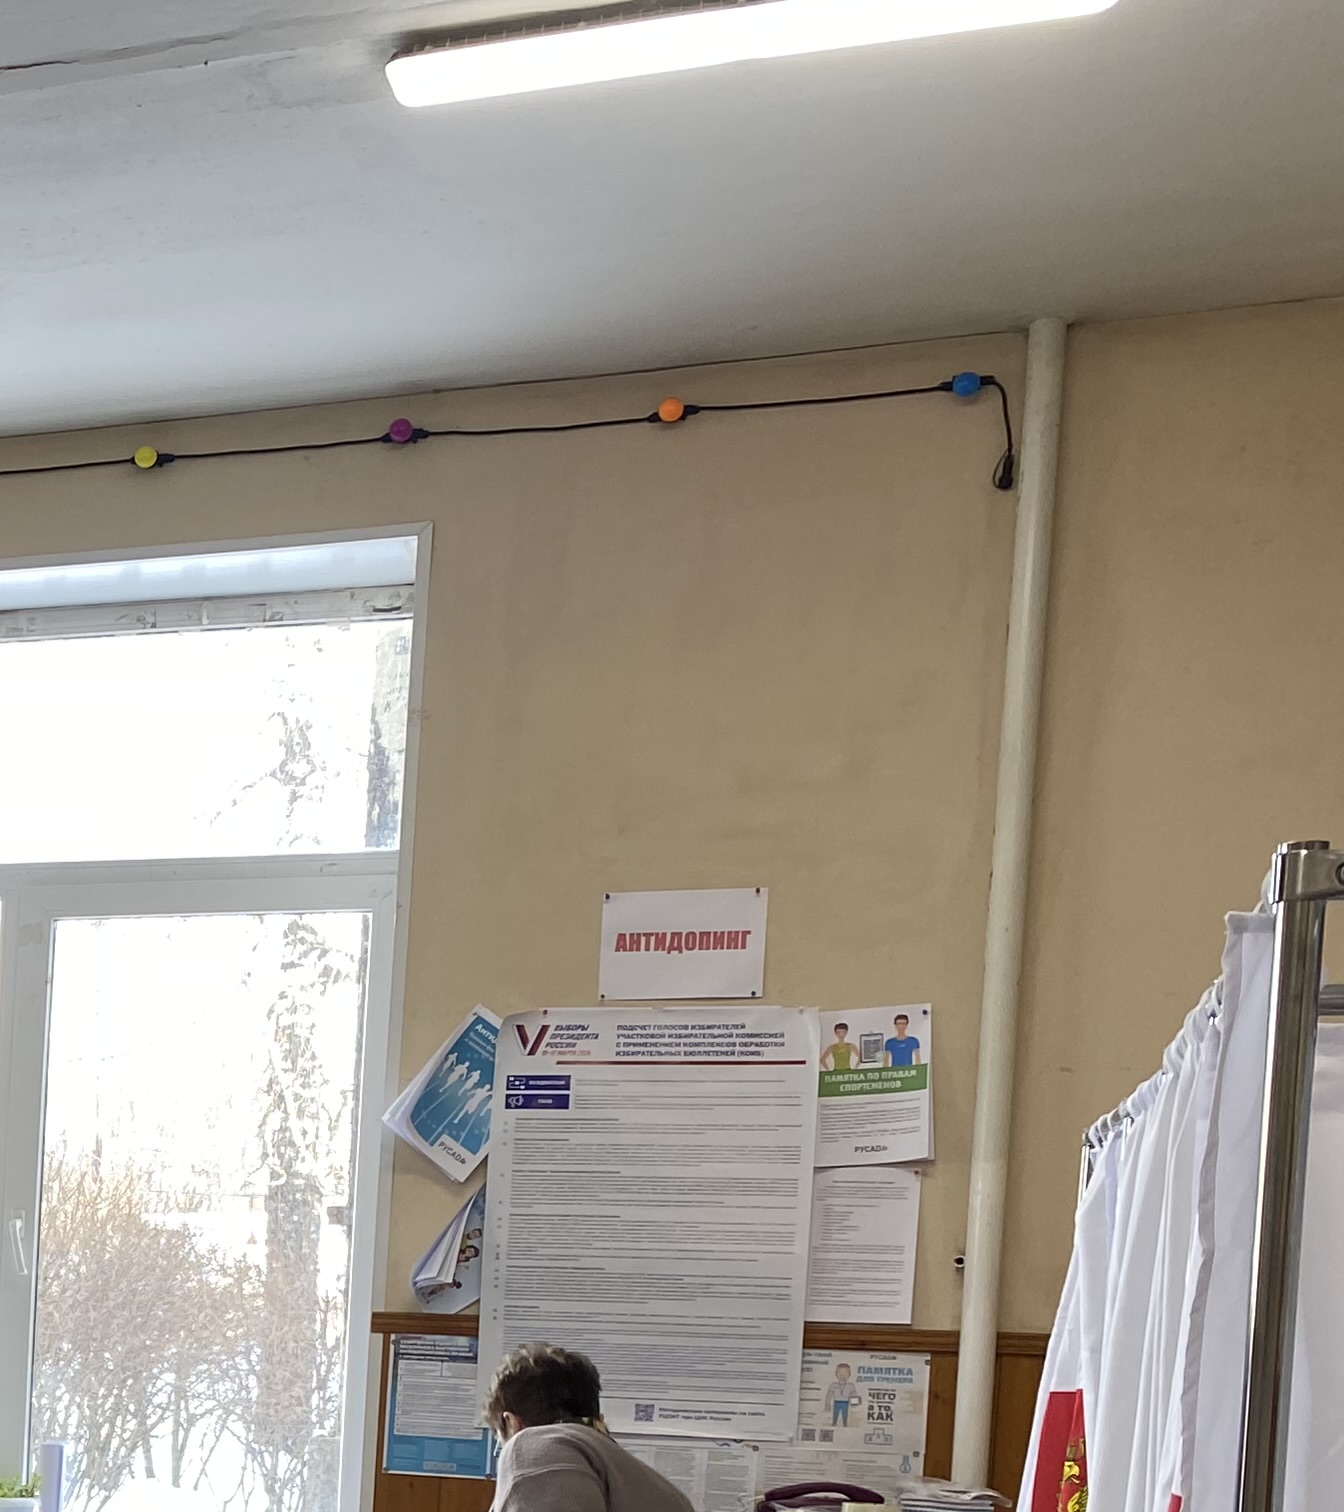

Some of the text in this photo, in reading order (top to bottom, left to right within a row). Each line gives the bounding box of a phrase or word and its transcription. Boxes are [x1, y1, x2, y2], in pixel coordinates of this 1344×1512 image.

[614, 930, 752, 954] АНТИДОПИНГ
[824, 1073, 866, 1083] ПАМЯТКА
[867, 1072, 880, 1080] ПО
[839, 1080, 902, 1092] СПОРТСМЕНОВ
[857, 1366, 914, 1376] ПАМЯТКА
[868, 1391, 897, 1401] ЧЕГО
[867, 1411, 894, 1422] КАК
